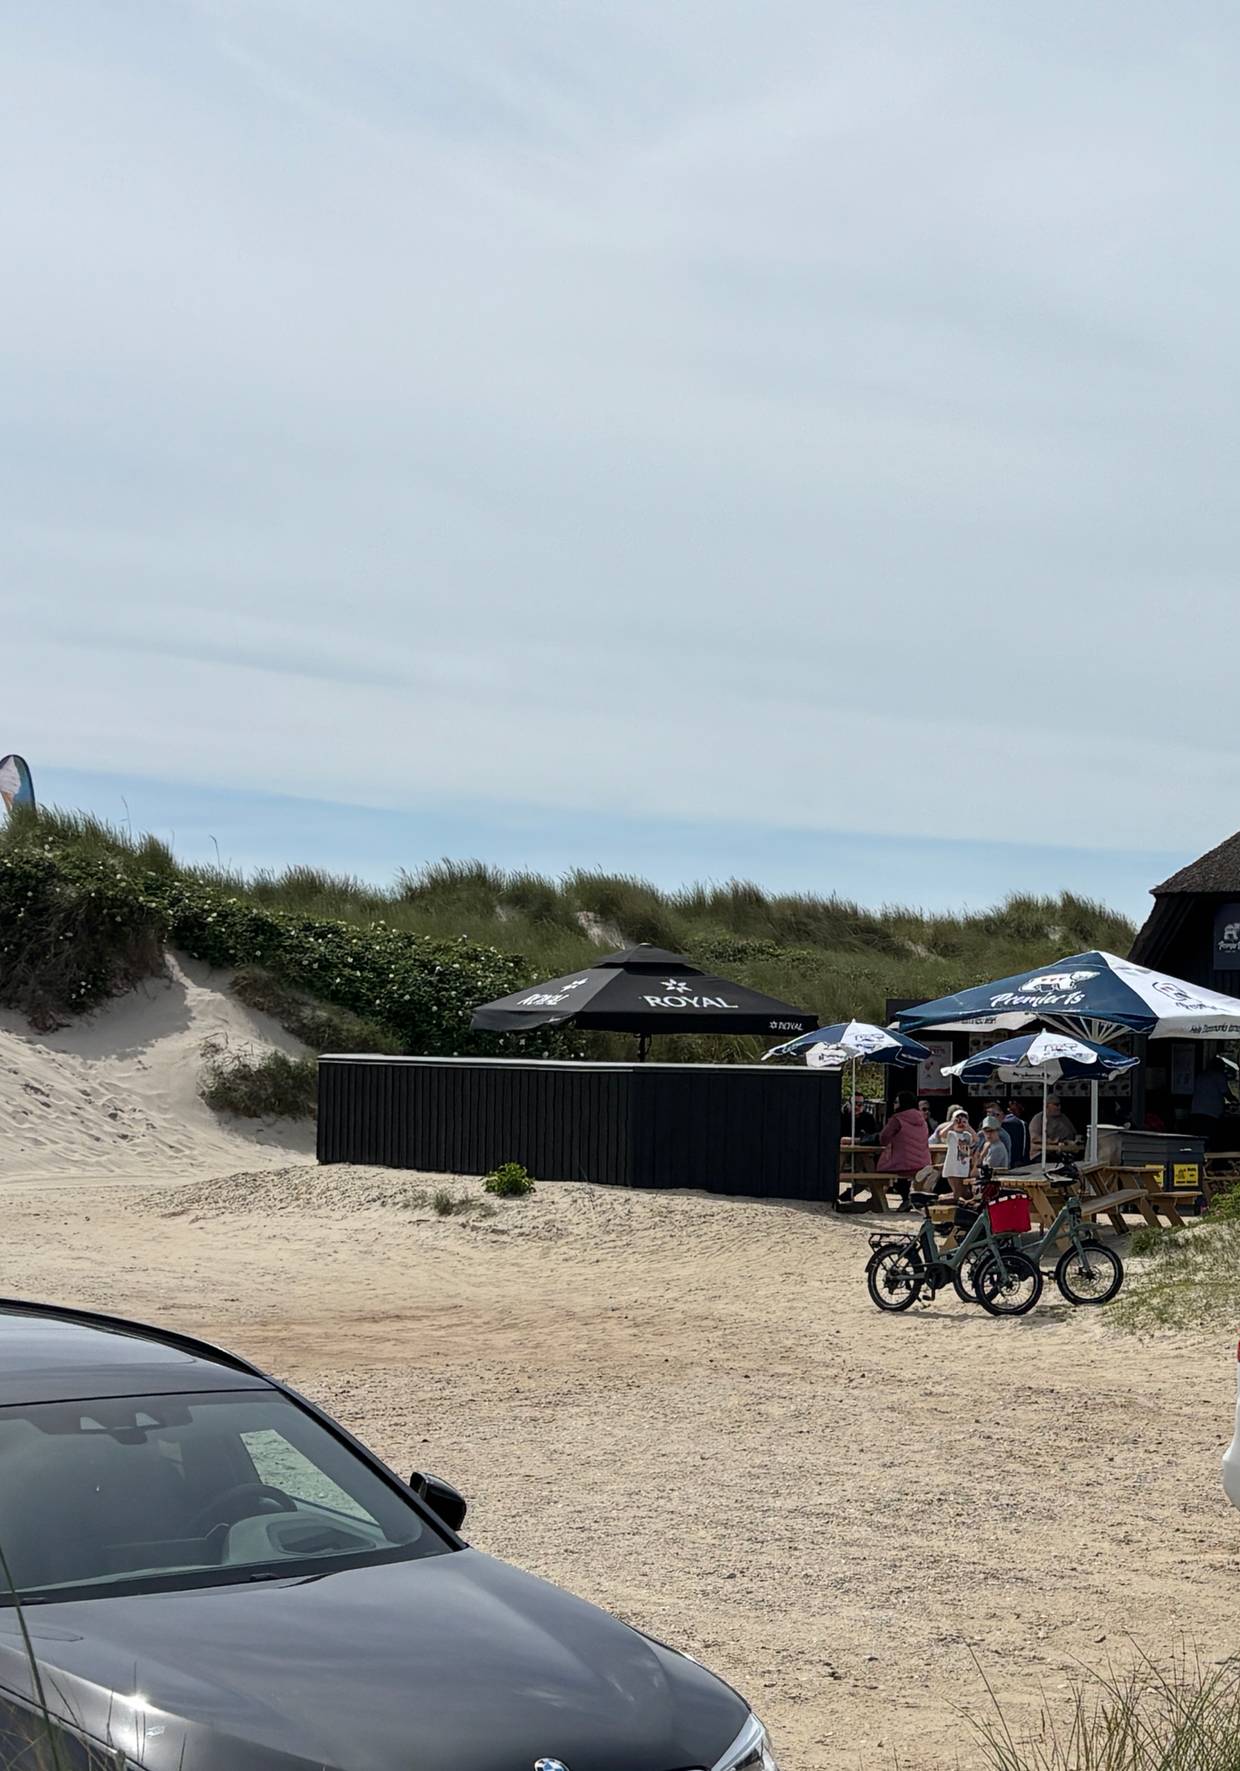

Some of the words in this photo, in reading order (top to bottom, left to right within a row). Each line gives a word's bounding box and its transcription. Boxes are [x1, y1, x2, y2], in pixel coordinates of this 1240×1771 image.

[642, 995, 739, 1008] ROYAL
[989, 992, 1063, 1007] Premier
[778, 1021, 804, 1031] ROYAL
